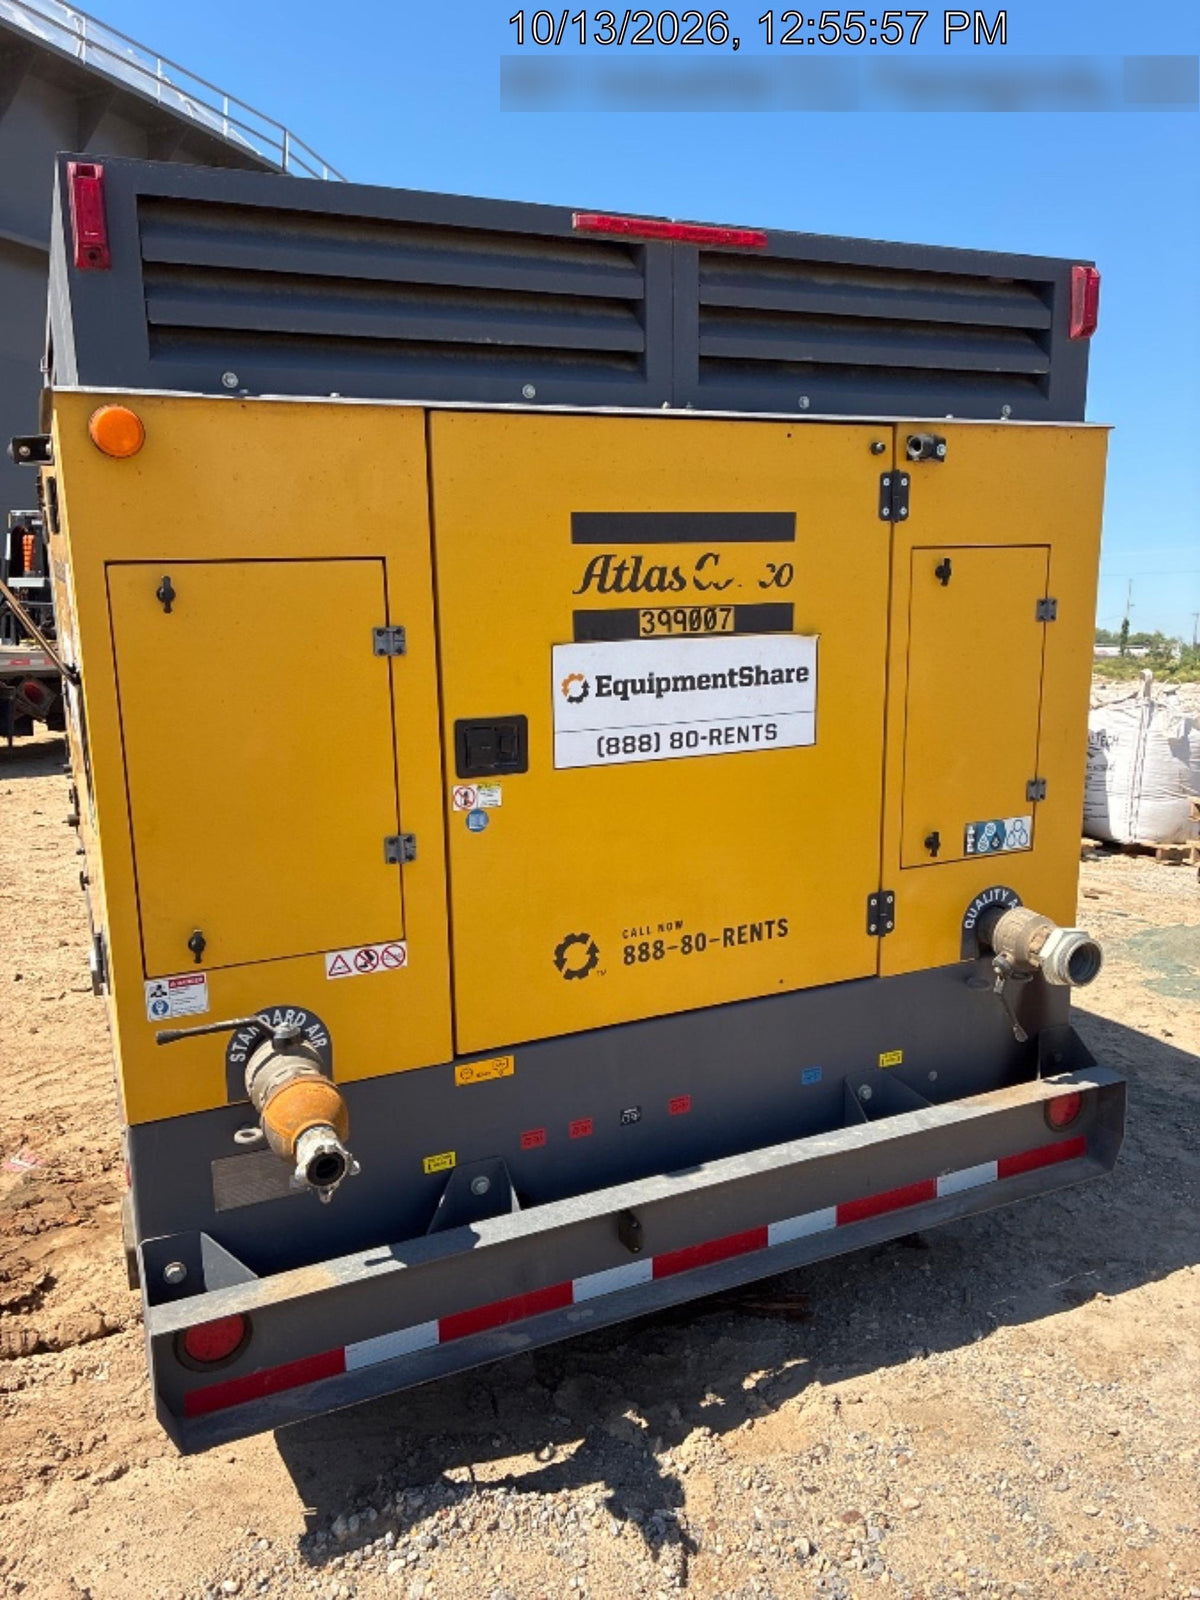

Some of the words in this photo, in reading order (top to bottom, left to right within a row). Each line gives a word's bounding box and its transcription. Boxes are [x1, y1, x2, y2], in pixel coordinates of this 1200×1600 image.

[572, 554, 687, 595] Atlas
[640, 607, 734, 634] 399007
[594, 665, 810, 701] EquipmentShare
[596, 731, 661, 758] (888)
[669, 723, 778, 750] 80-RENTS
[964, 888, 1010, 929] QUALITY
[622, 927, 651, 940] CALL
[657, 919, 684, 933] NOW
[623, 917, 789, 967] 888-80-RENTS
[305, 1023, 328, 1049] AIR
